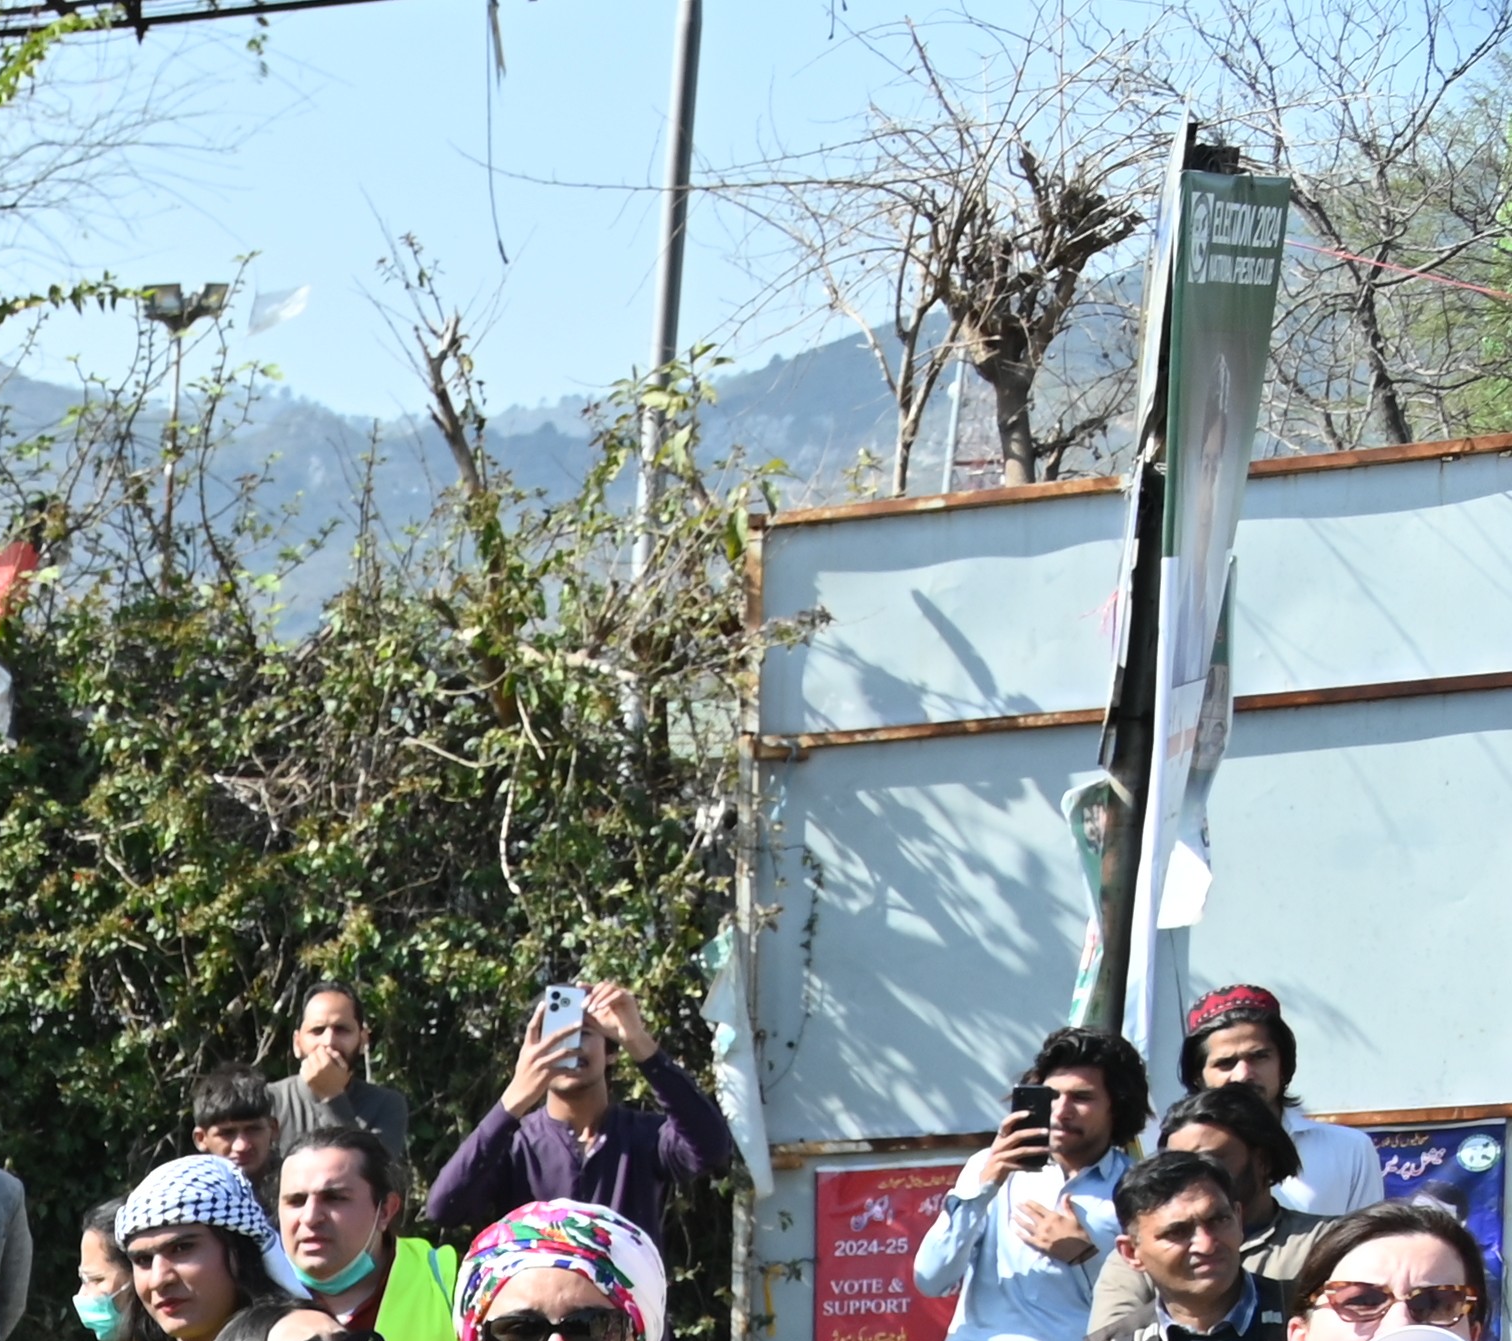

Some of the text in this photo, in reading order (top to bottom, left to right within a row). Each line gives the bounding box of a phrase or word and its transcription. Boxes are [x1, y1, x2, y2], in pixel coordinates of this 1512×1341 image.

[834, 1238, 908, 1256] 2024-25
[830, 1278, 904, 1295] VOTE &
[823, 1298, 911, 1316] SUPPORT
